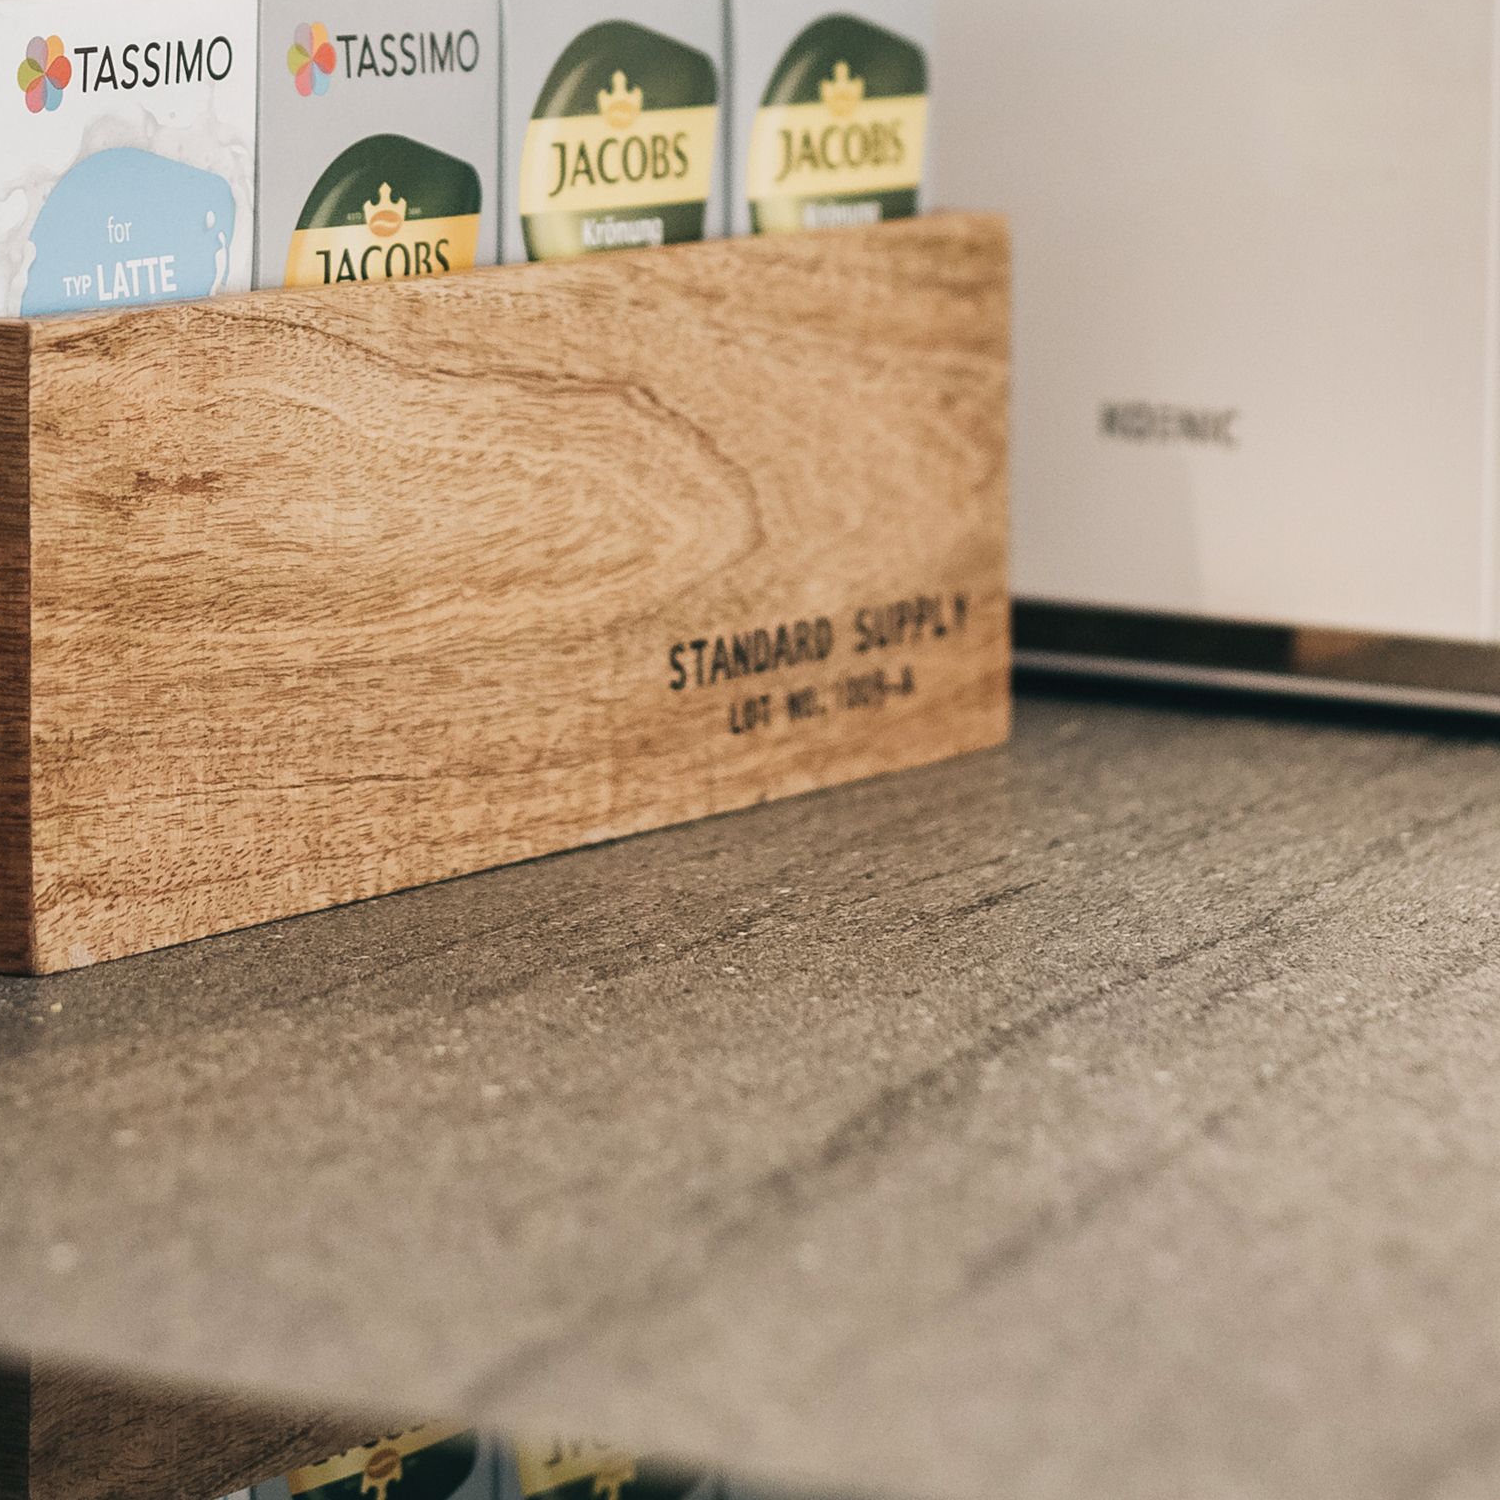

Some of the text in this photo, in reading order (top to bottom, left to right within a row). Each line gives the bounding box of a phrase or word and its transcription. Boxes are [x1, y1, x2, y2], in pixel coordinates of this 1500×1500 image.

[73, 34, 233, 94] TASSIMO
[336, 28, 480, 79] TASSIMO
[548, 131, 689, 197] JACOBS
[772, 117, 907, 184] JACOBS
[106, 215, 132, 244] for
[62, 254, 178, 302] TYP LATTE
[668, 593, 970, 692] STANDARD SUPPLY
[729, 692, 772, 735] LOT
